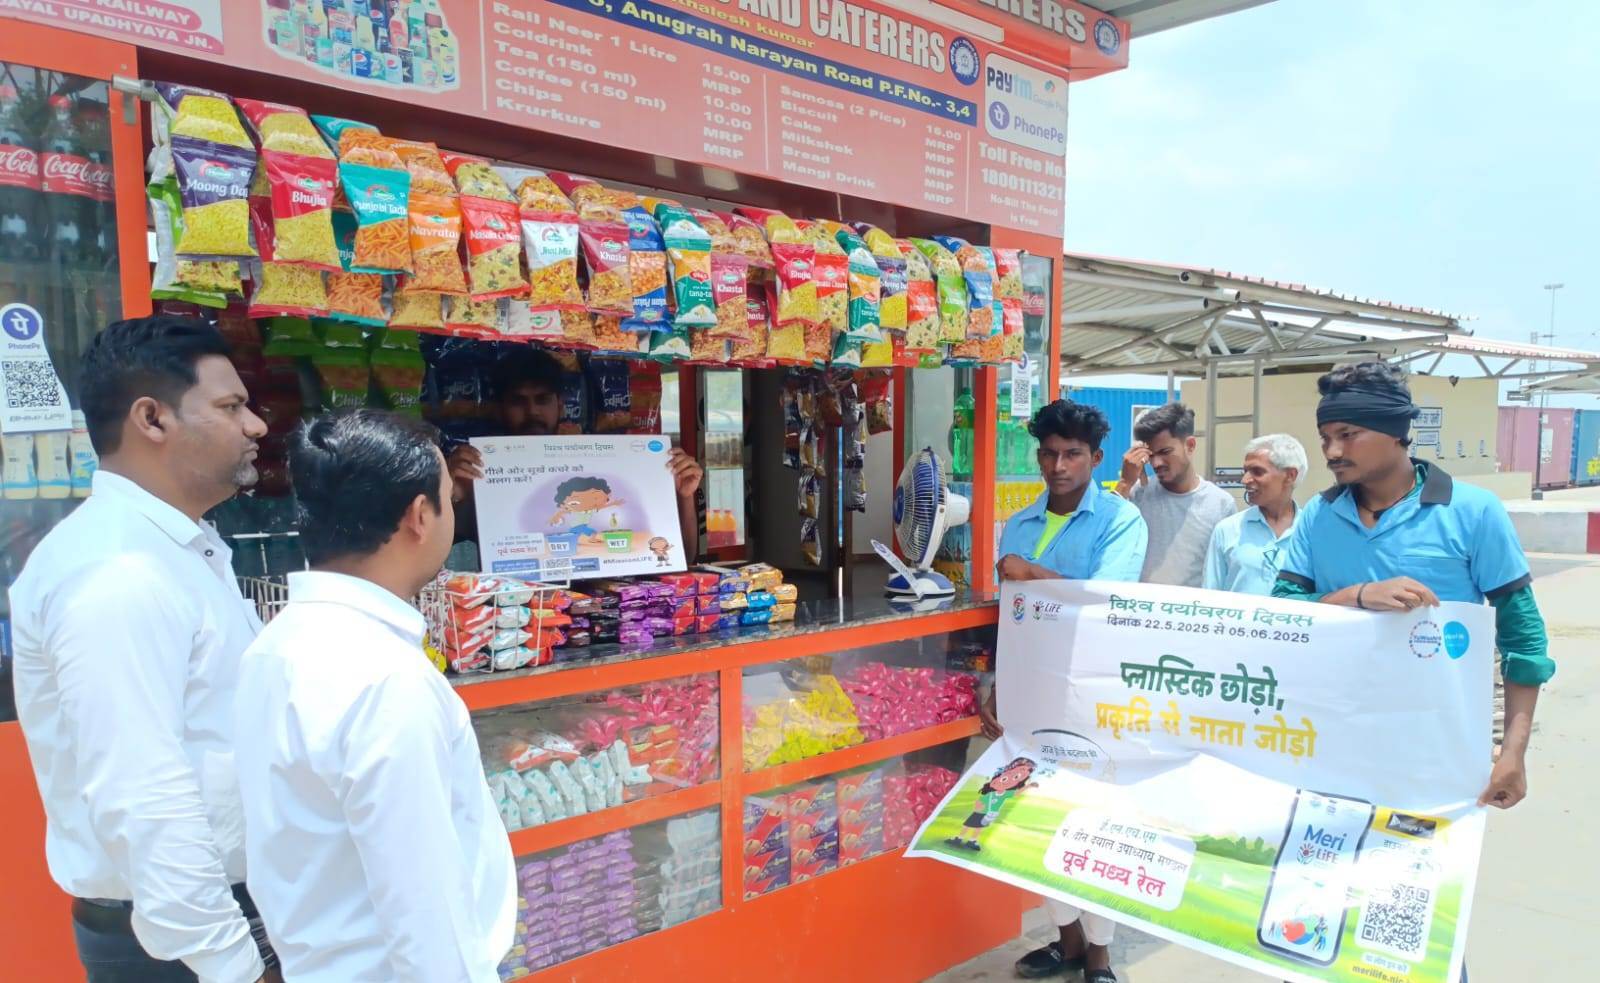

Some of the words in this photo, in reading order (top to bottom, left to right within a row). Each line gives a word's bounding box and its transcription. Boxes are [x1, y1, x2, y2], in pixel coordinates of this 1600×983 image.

[96, 0, 190, 25] RAILWAY
[0, 0, 58, 16] AYAL
[64, 7, 179, 42] UPADHYAYA
[185, 32, 213, 49] JN.
[493, 2, 540, 24] Rail
[610, 36, 620, 47] 1
[630, 40, 677, 63] Litre
[494, 22, 593, 56] Coldrink
[808, 0, 946, 74] CATERERS
[494, 40, 539, 60] Tea
[547, 54, 597, 75] (150
[604, 70, 637, 87] ml)
[621, 1, 723, 44] Anugrah
[731, 35, 818, 74] Narayan
[824, 64, 873, 89] Road
[946, 100, 971, 118] 3,4
[702, 63, 751, 84] 15.00
[495, 60, 573, 87] Coffee
[581, 80, 628, 101] (150
[634, 94, 667, 112] ml)
[495, 78, 563, 102] Chips
[702, 78, 742, 96] MRP
[780, 84, 845, 111] Samosa
[703, 95, 752, 115] 10.00
[780, 100, 838, 123] Biscuit
[703, 111, 752, 131] 10.00
[781, 115, 822, 133] Cake
[1014, 116, 1064, 143] PhonePe
[703, 126, 743, 143] MRP
[925, 137, 956, 152] MRP
[703, 142, 744, 159] MRP
[782, 145, 831, 165] Bread
[925, 151, 955, 166] MRP
[978, 142, 1007, 163] Toll
[1009, 150, 1042, 173] Free
[836, 171, 877, 190] Drink
[924, 165, 954, 179] MRP
[186, 178, 228, 198] Moong
[924, 178, 954, 193] MRP
[981, 168, 1063, 201] 1800111321
[292, 191, 327, 207] Bhujia
[924, 191, 954, 205] MRP
[600, 250, 627, 264] Khasta
[717, 284, 743, 294] Khasta
[10, 311, 29, 336] पे
[747, 311, 765, 321] hasta
[550, 543, 568, 551] DRY
[1109, 594, 1155, 613] विश्व
[1160, 600, 1245, 621] पर्यावरण
[1253, 608, 1314, 627] दिवस
[1107, 613, 1141, 628] दिनांक
[1145, 619, 1210, 634] 22.5.2025
[1213, 621, 1225, 636] से
[1229, 627, 1310, 644] 05.06.2025
[1120, 654, 1215, 698] प्लास्टिक
[1220, 662, 1285, 716] छोड़ो,
[1095, 695, 1152, 740] प्रकृति
[1159, 699, 1181, 736] से
[1188, 715, 1246, 747] नाता
[1253, 713, 1318, 763] जोड़ो
[1091, 835, 1115, 850] दयाल
[1116, 842, 1155, 863] उपाध्याय
[1303, 823, 1347, 852] Meri
[1063, 849, 1091, 875] पूर्व
[1092, 859, 1133, 886] मध्य
[1137, 865, 1167, 897] रेल
